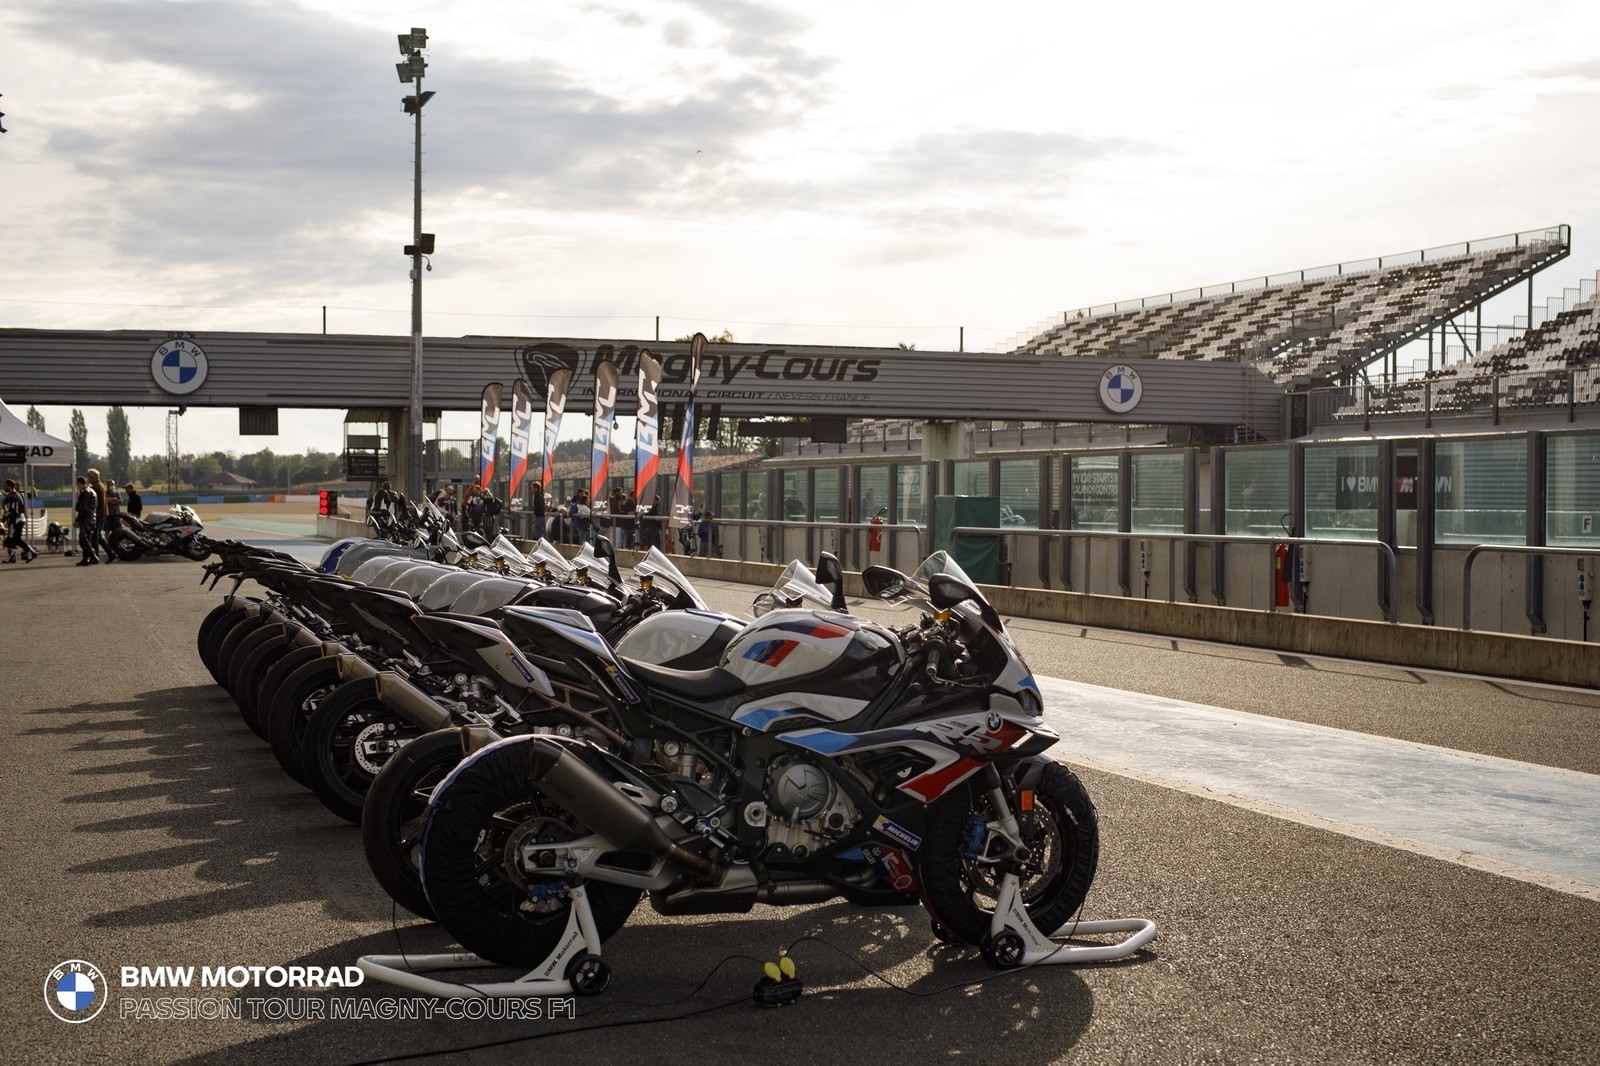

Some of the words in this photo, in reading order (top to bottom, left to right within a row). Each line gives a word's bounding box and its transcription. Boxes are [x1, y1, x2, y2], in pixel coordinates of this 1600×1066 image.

[158, 341, 201, 357] BMW
[588, 344, 882, 385] Mgny-Cours
[1105, 366, 1137, 380] BMW
[706, 390, 766, 400] CIRCUIT
[774, 391, 822, 401] NEVERS
[1583, 517, 1591, 530] F
[886, 825, 919, 847] MICHELIN
[543, 960, 558, 977] BMW
[556, 931, 579, 960] Motorrad
